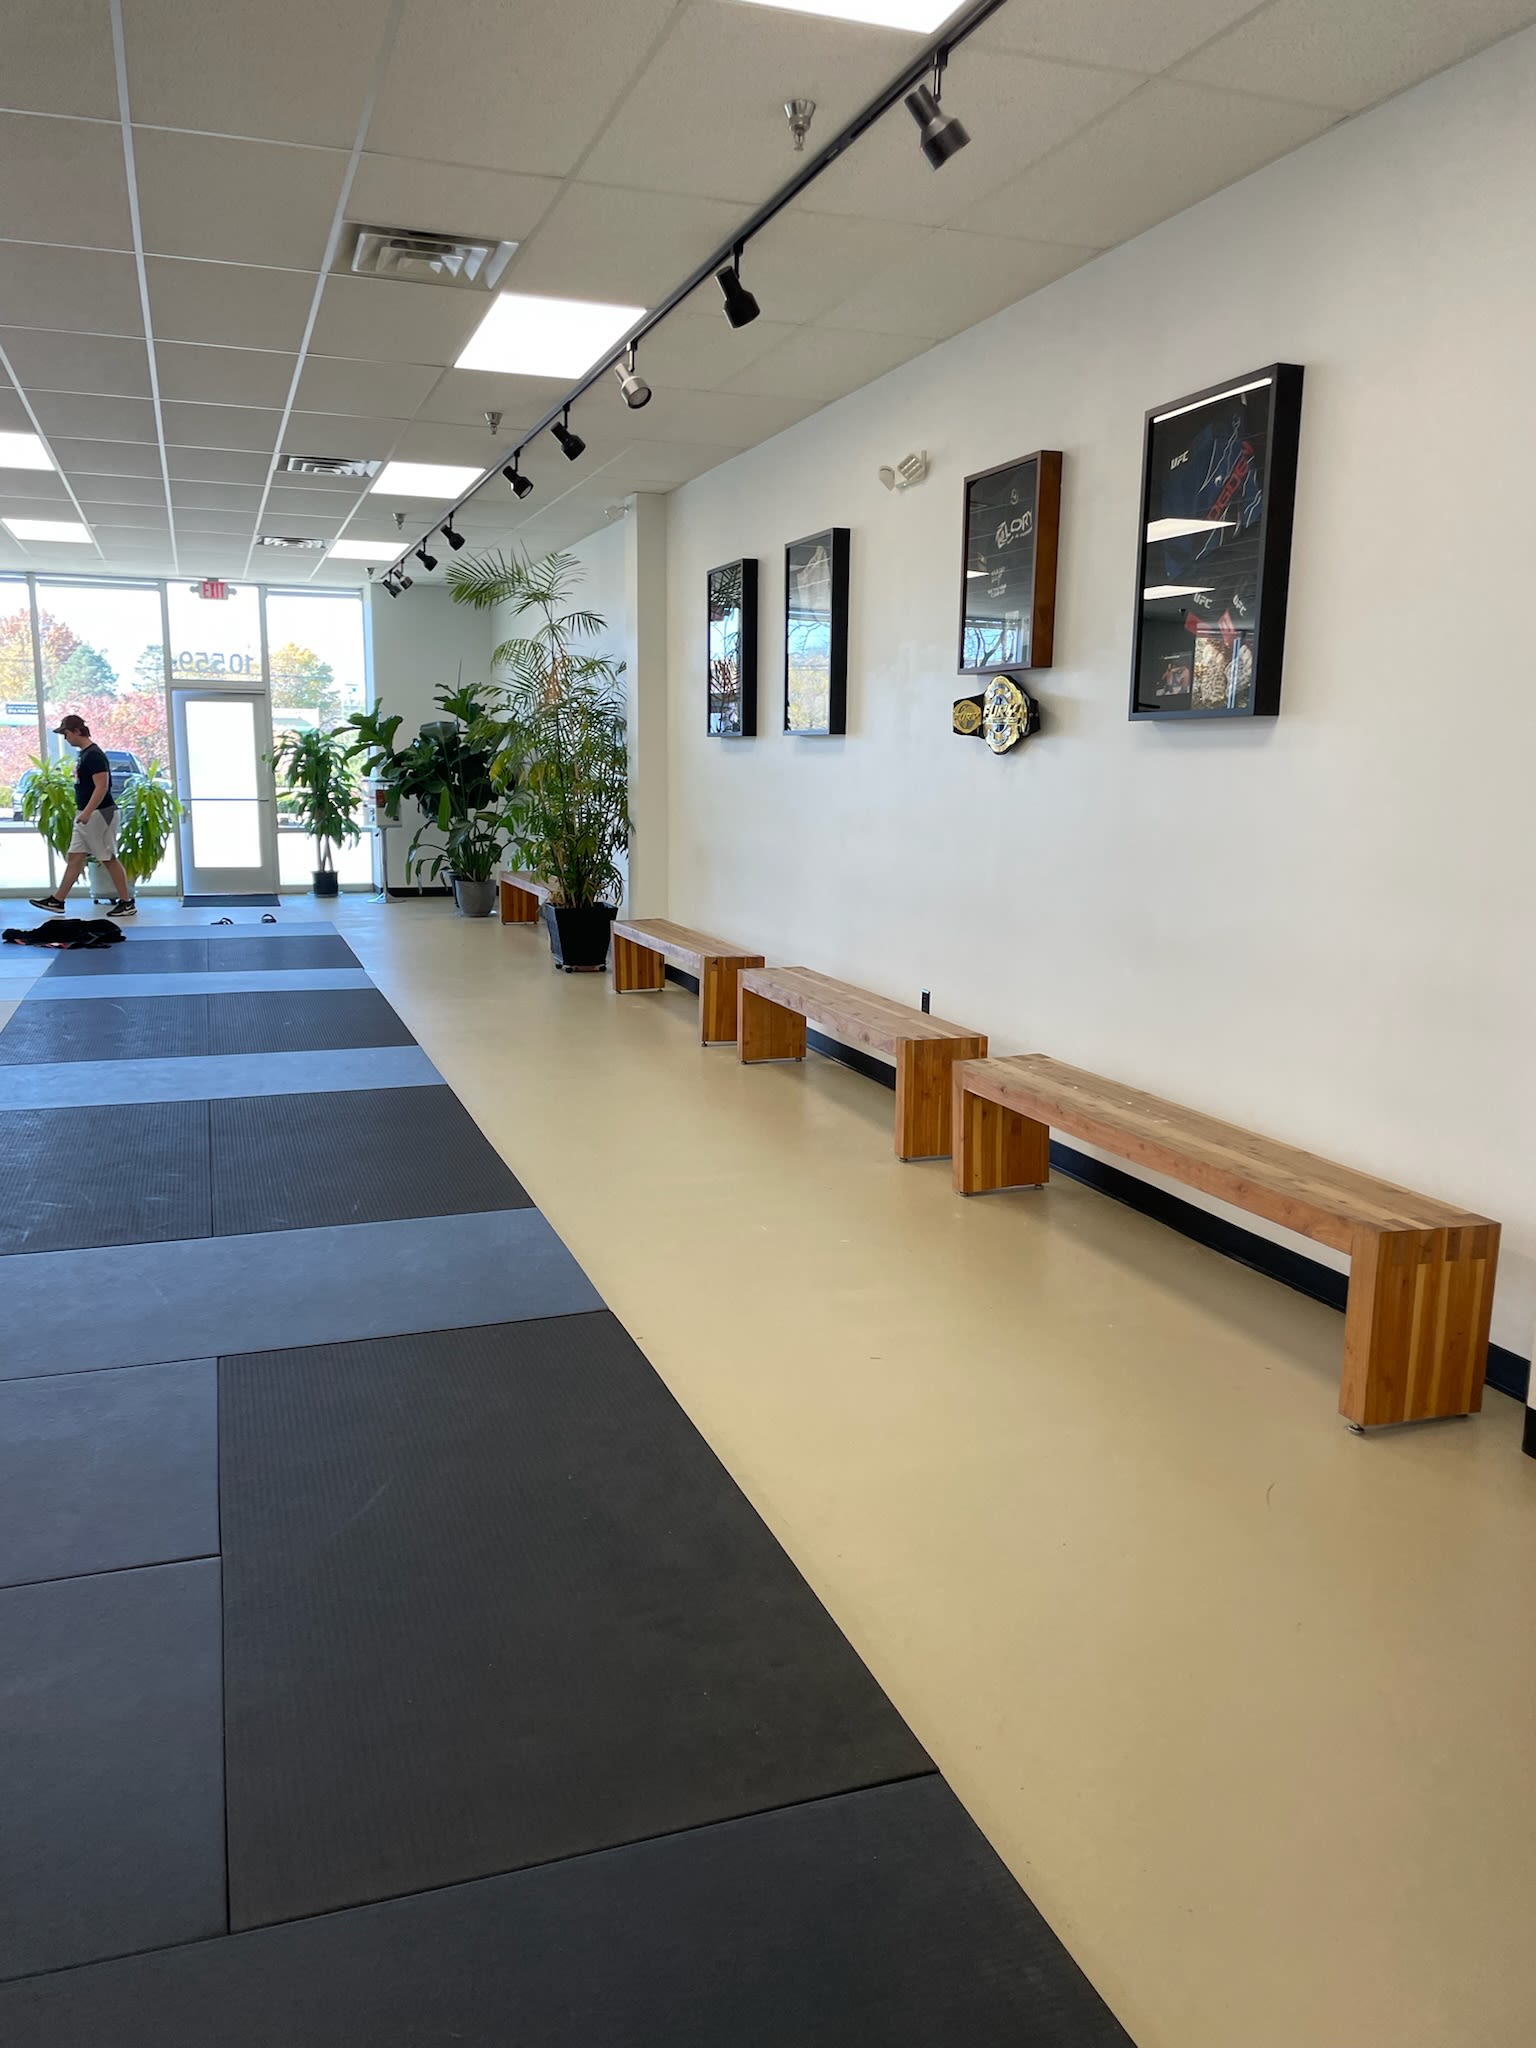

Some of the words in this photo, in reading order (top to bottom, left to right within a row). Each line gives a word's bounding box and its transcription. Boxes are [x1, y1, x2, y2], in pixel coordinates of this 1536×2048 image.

[1170, 449, 1189, 470] UFC
[202, 582, 224, 598] EXIT
[1193, 592, 1213, 609] UFC
[1232, 594, 1247, 616] UFC
